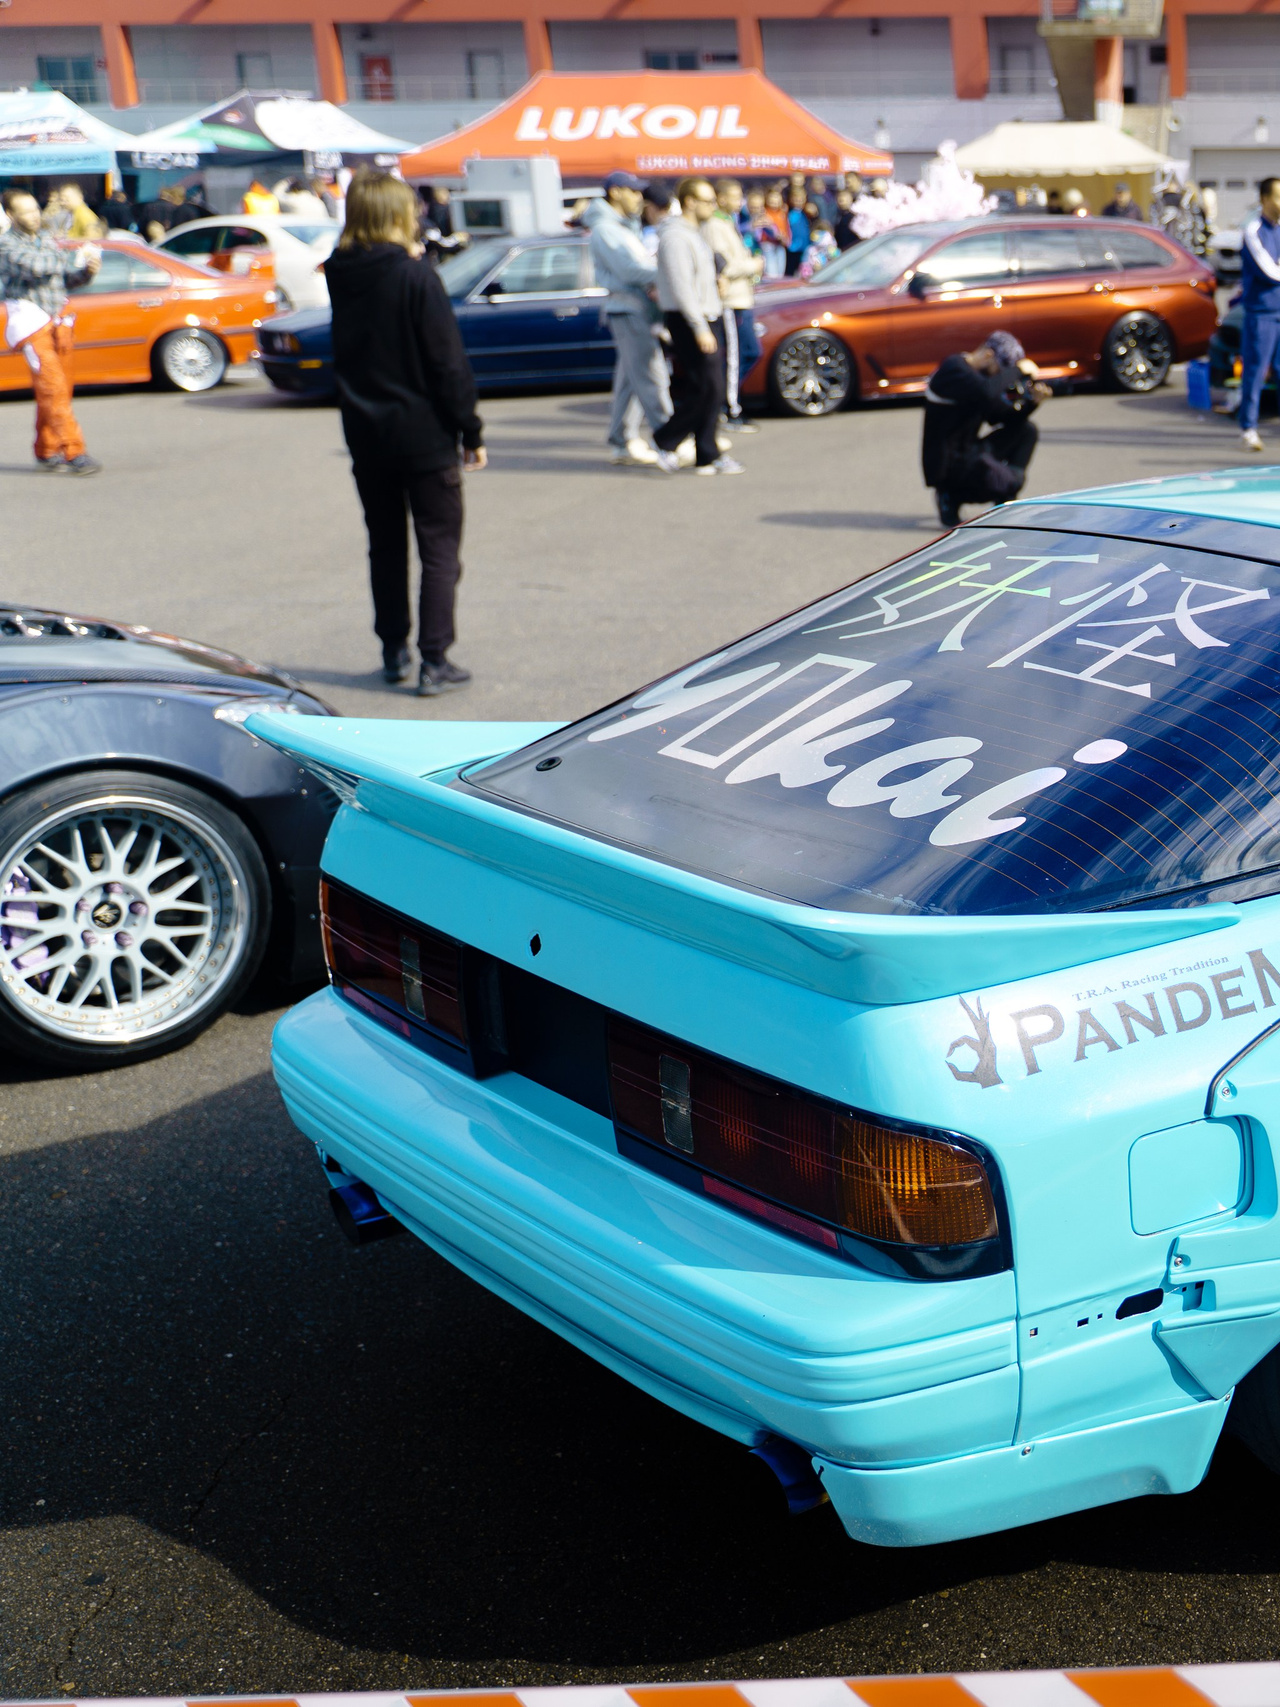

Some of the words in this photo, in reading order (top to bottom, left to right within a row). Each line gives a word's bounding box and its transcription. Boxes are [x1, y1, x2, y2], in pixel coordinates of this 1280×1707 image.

[514, 103, 750, 141] LUKOIL
[1072, 985, 1118, 1002] T.R.A.
[1121, 971, 1168, 990] Racing
[1168, 955, 1230, 977] Tradition
